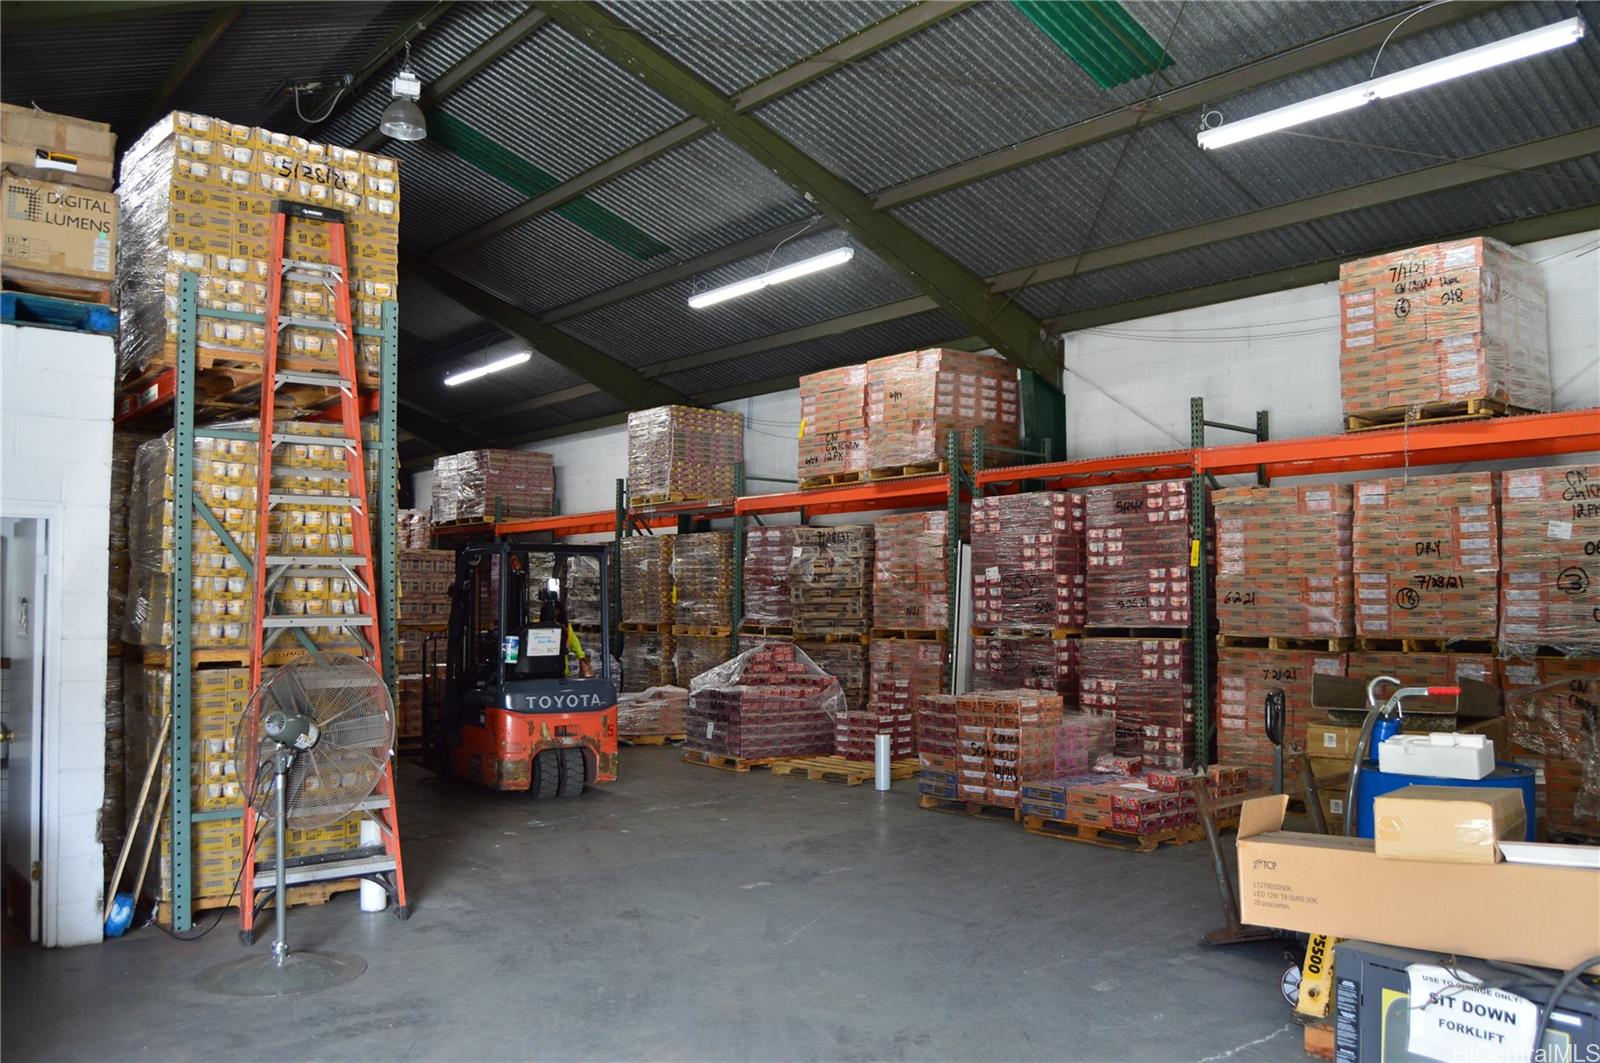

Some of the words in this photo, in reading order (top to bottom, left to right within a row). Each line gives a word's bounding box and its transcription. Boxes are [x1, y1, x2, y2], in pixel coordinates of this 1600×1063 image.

[47, 191, 111, 214] DIGITAL
[45, 212, 111, 234] LUMENS
[1415, 540, 1441, 557] DRY
[525, 693, 601, 709] TOYOTA
[1263, 860, 1278, 871] TCP
[1421, 974, 1439, 985] USE
[1442, 979, 1455, 989] TO
[1429, 991, 1458, 1009] SIT
[1461, 1000, 1517, 1026] DOWN
[1437, 1018, 1505, 1045] FORKLIFT
